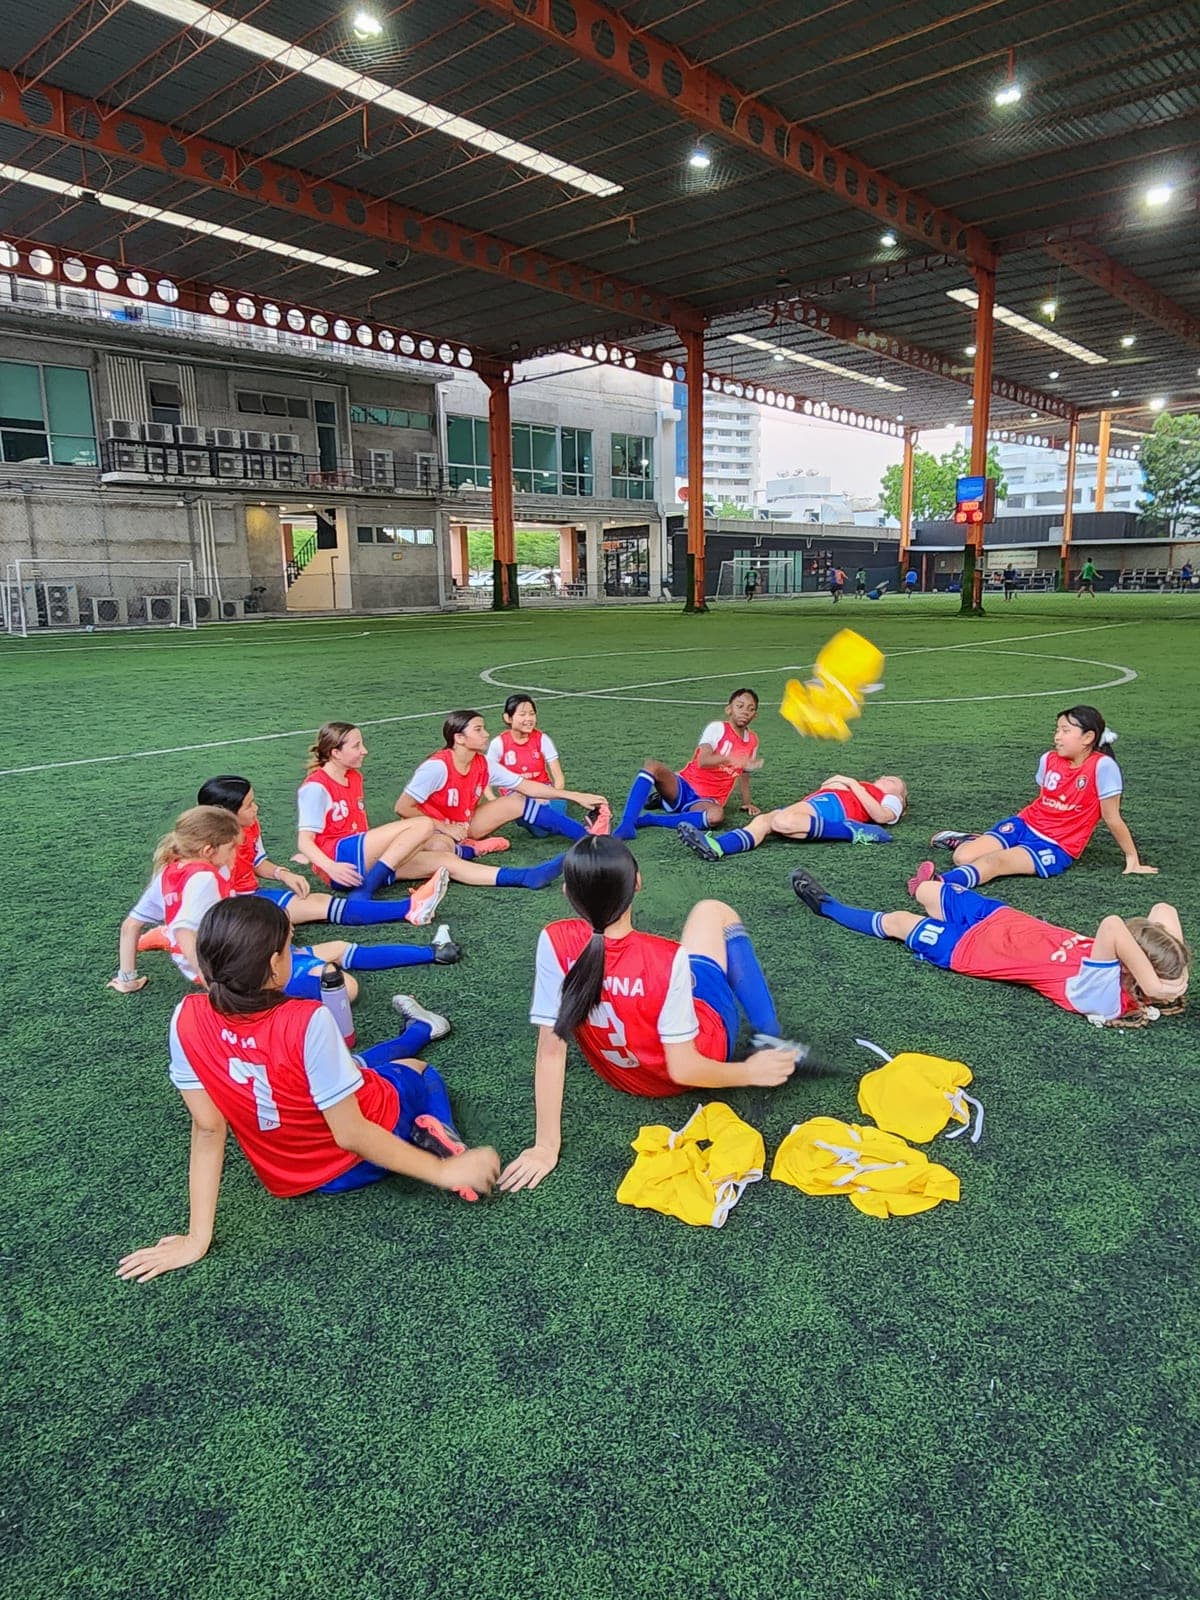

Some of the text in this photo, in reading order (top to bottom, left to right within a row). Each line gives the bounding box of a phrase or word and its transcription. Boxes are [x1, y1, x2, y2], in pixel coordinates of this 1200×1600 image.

[1044, 770, 1061, 791] 16
[332, 799, 350, 822] 26
[1038, 848, 1056, 866] 16
[919, 923, 945, 946] 10
[228, 1057, 282, 1132] 7
